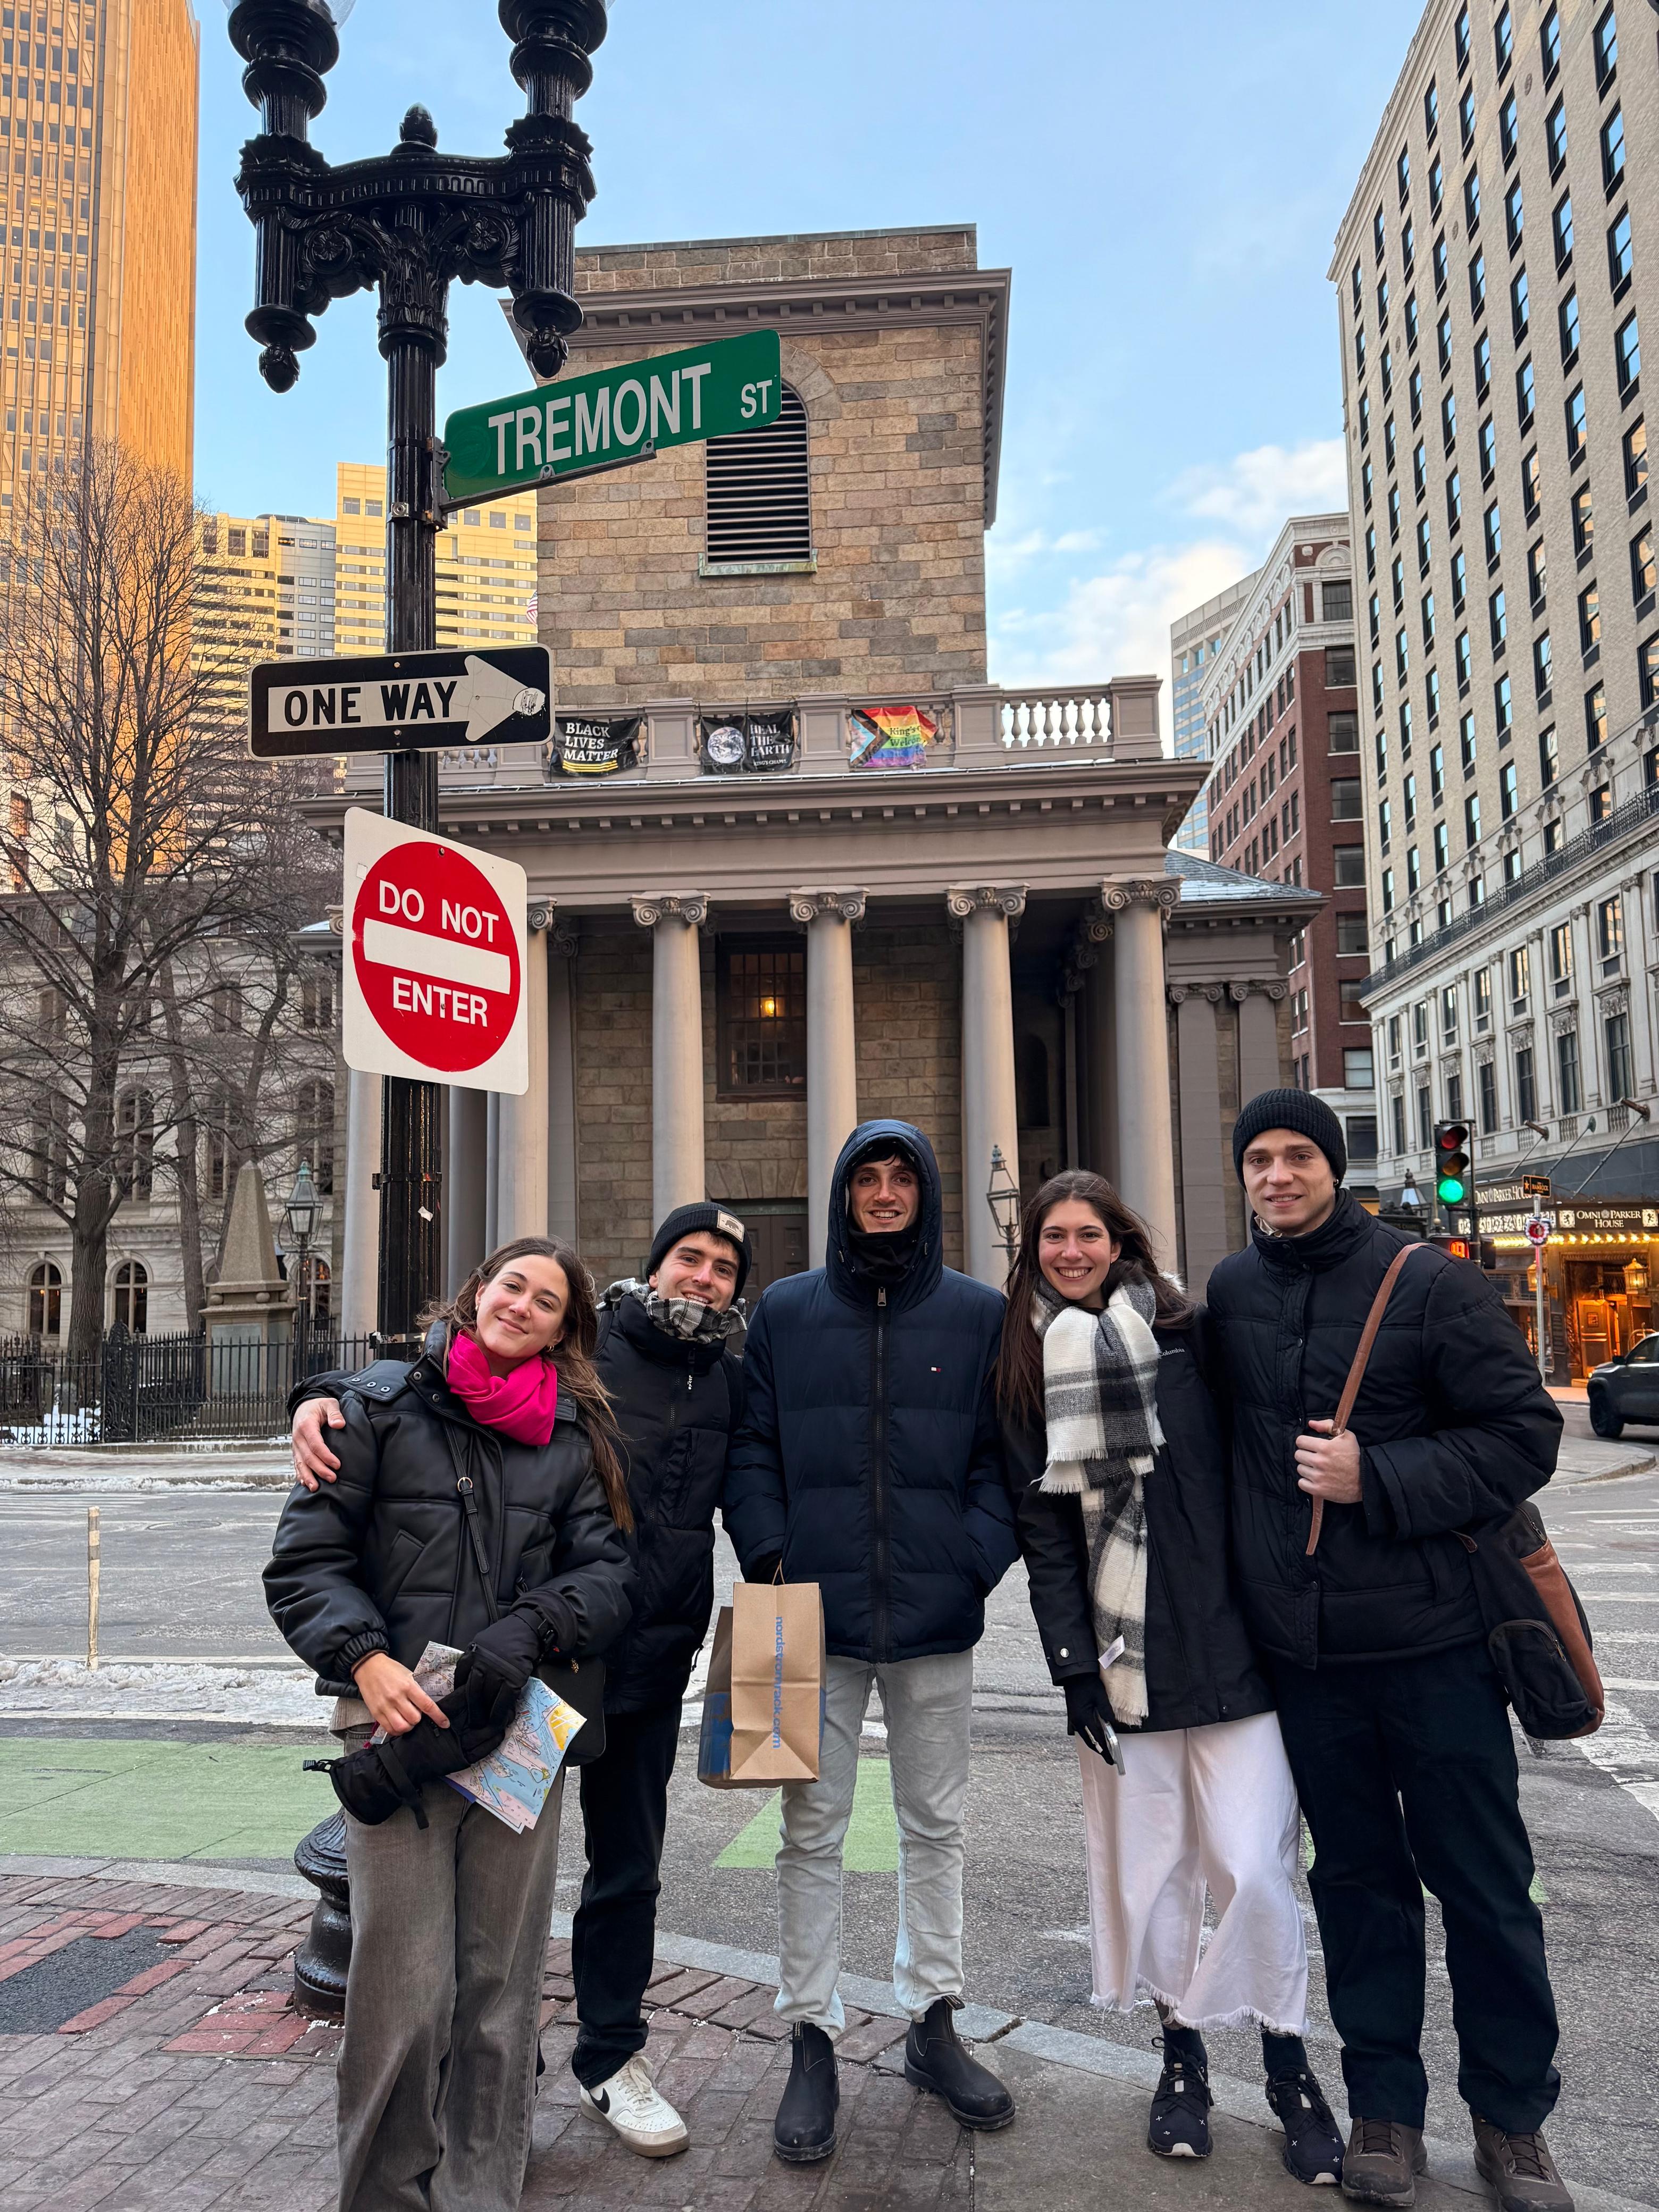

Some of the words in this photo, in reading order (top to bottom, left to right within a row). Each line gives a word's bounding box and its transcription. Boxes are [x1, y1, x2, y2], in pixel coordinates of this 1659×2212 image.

[488, 362, 711, 475] TREMONT
[741, 380, 773, 418] ST
[284, 687, 362, 727] ONE
[380, 681, 458, 721] WAY
[566, 722, 610, 738] BLACK
[750, 724, 781, 734] HEAL
[890, 726, 916, 736] King's
[565, 735, 605, 749] LIVES
[750, 735, 774, 745] THE
[564, 748, 618, 761] MATTER
[751, 744, 790, 757] EARTH
[379, 880, 424, 922] DO
[442, 899, 499, 943] NOT
[393, 976, 488, 1027] ENTER
[1493, 1188, 1512, 1202] PARKER
[1577, 1210, 1600, 1219] OMNI
[1610, 1210, 1641, 1219] PARKER
[1595, 1219, 1624, 1228] HOUSE
[773, 1616, 785, 1748] nordstromrack.com
